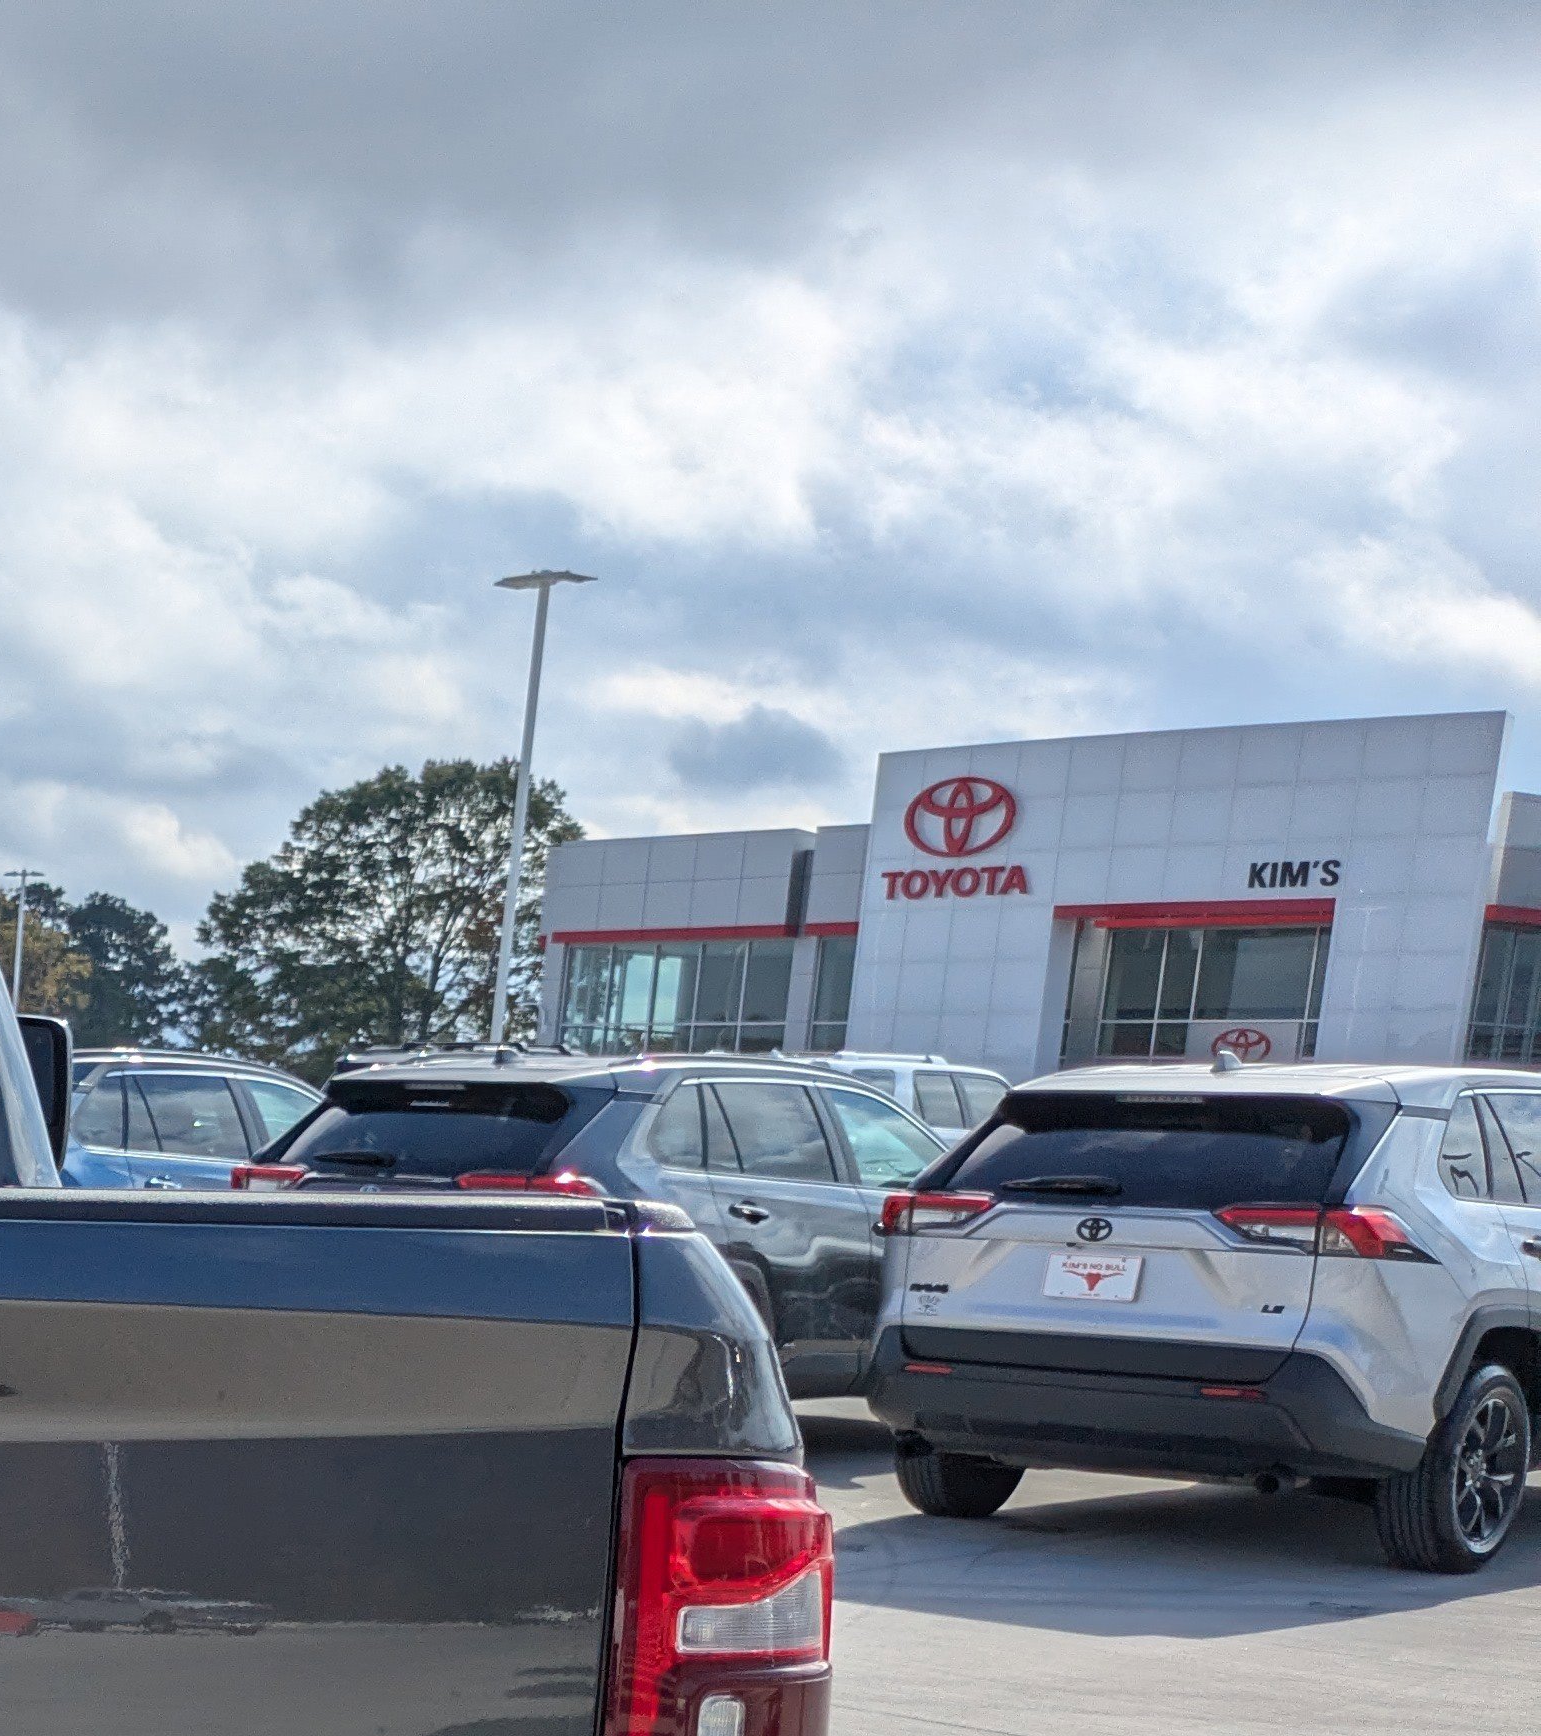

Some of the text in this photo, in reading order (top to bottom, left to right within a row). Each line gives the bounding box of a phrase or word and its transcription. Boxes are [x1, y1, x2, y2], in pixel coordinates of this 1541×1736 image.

[880, 865, 1032, 900] TOYOTA
[1247, 859, 1341, 888] KIM'S
[1061, 1261, 1087, 1270] KIM'S
[1105, 1263, 1127, 1272] BULL
